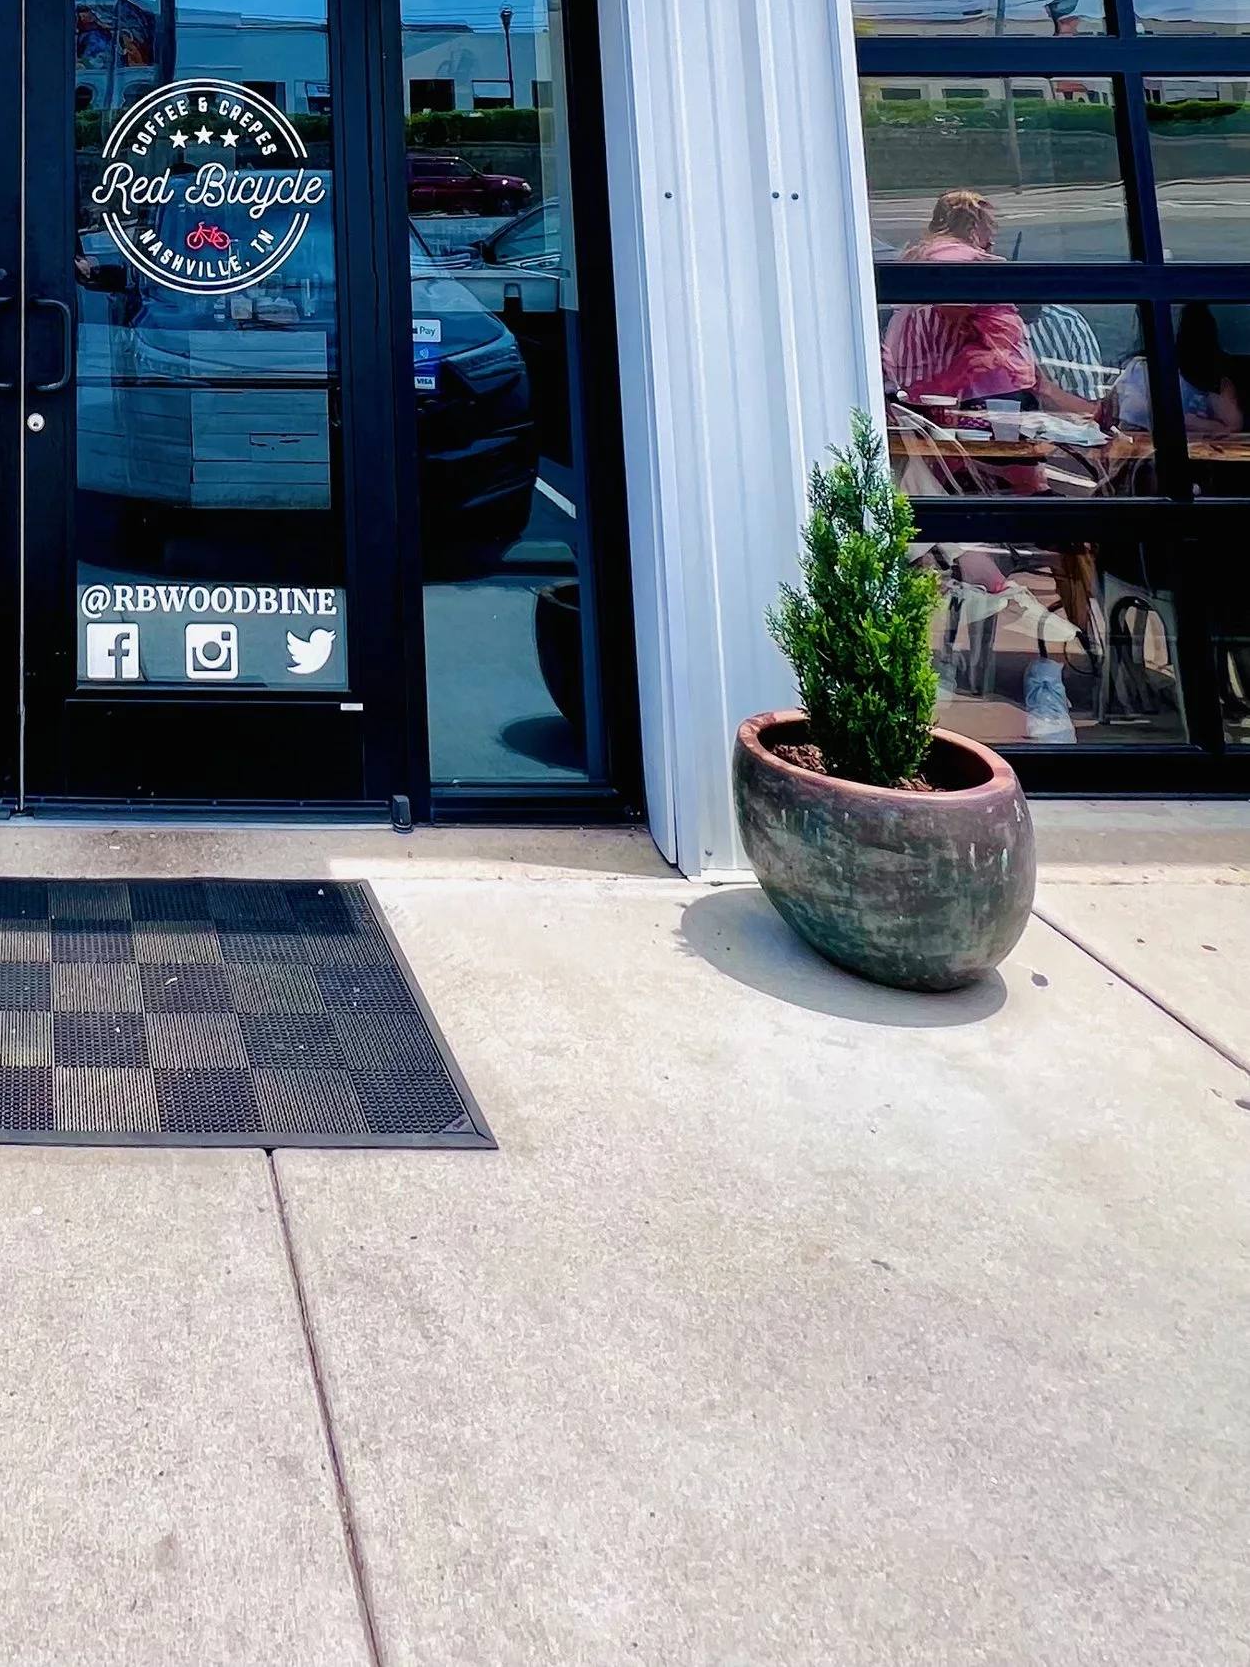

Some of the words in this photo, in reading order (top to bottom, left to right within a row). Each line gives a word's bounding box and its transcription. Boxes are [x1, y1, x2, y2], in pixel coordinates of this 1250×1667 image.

[131, 99, 189, 156] COFFEE
[198, 96, 208, 113] &
[218, 99, 278, 156] CREPES
[91, 161, 175, 215] Red
[184, 161, 326, 220] Bicycle
[139, 228, 251, 278] NASHVILLE,
[250, 228, 275, 254] TN
[81, 584, 338, 619] @RBWOODBINE
